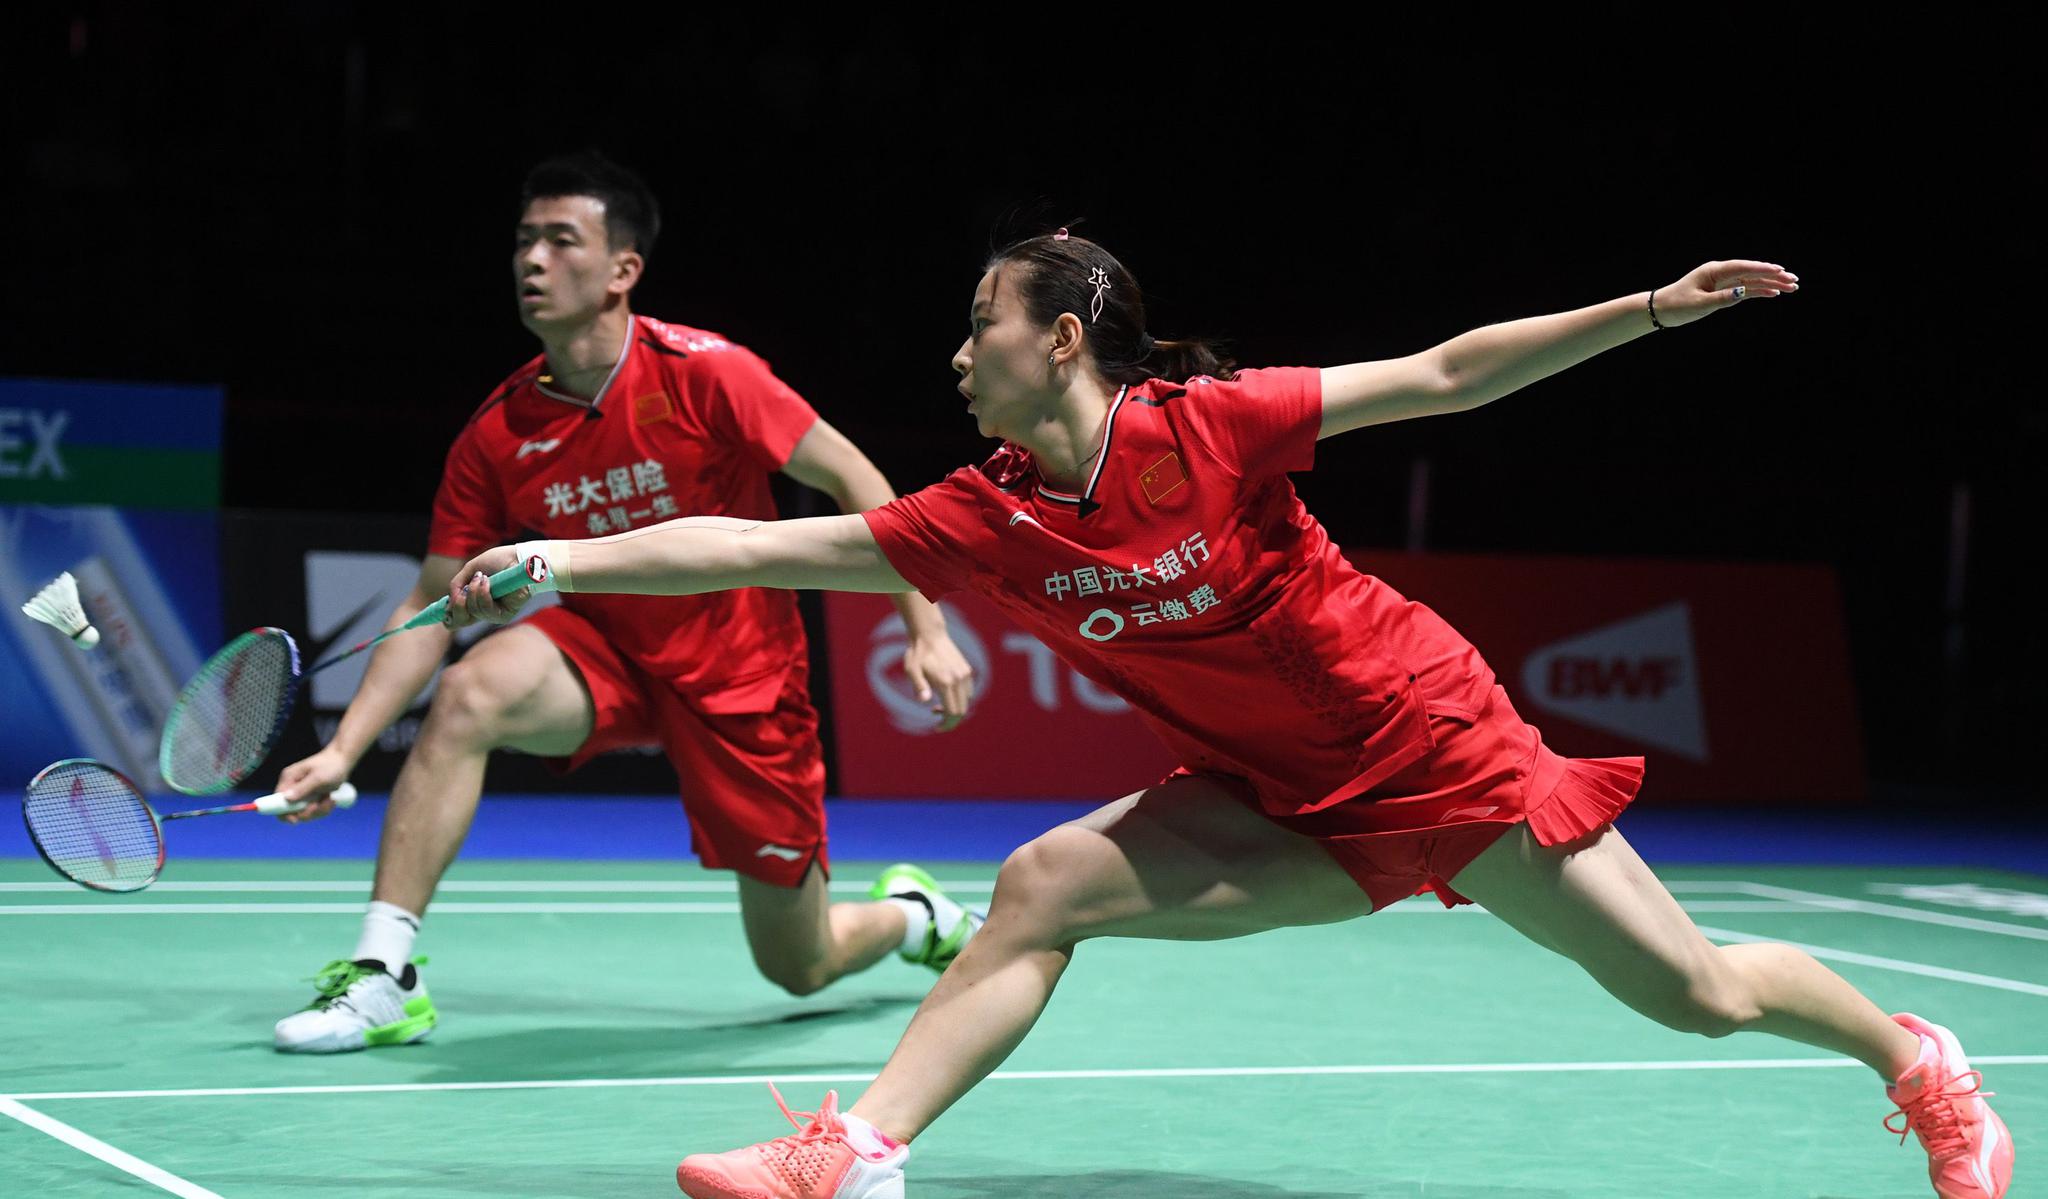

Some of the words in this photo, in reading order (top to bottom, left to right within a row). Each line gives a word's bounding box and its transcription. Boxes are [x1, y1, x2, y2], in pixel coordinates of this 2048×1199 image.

[543, 459, 669, 518] 光大保险
[1044, 531, 1210, 601] 中国光大银行
[1131, 583, 1221, 626] 云缴费
[1550, 656, 1681, 698] BWF
